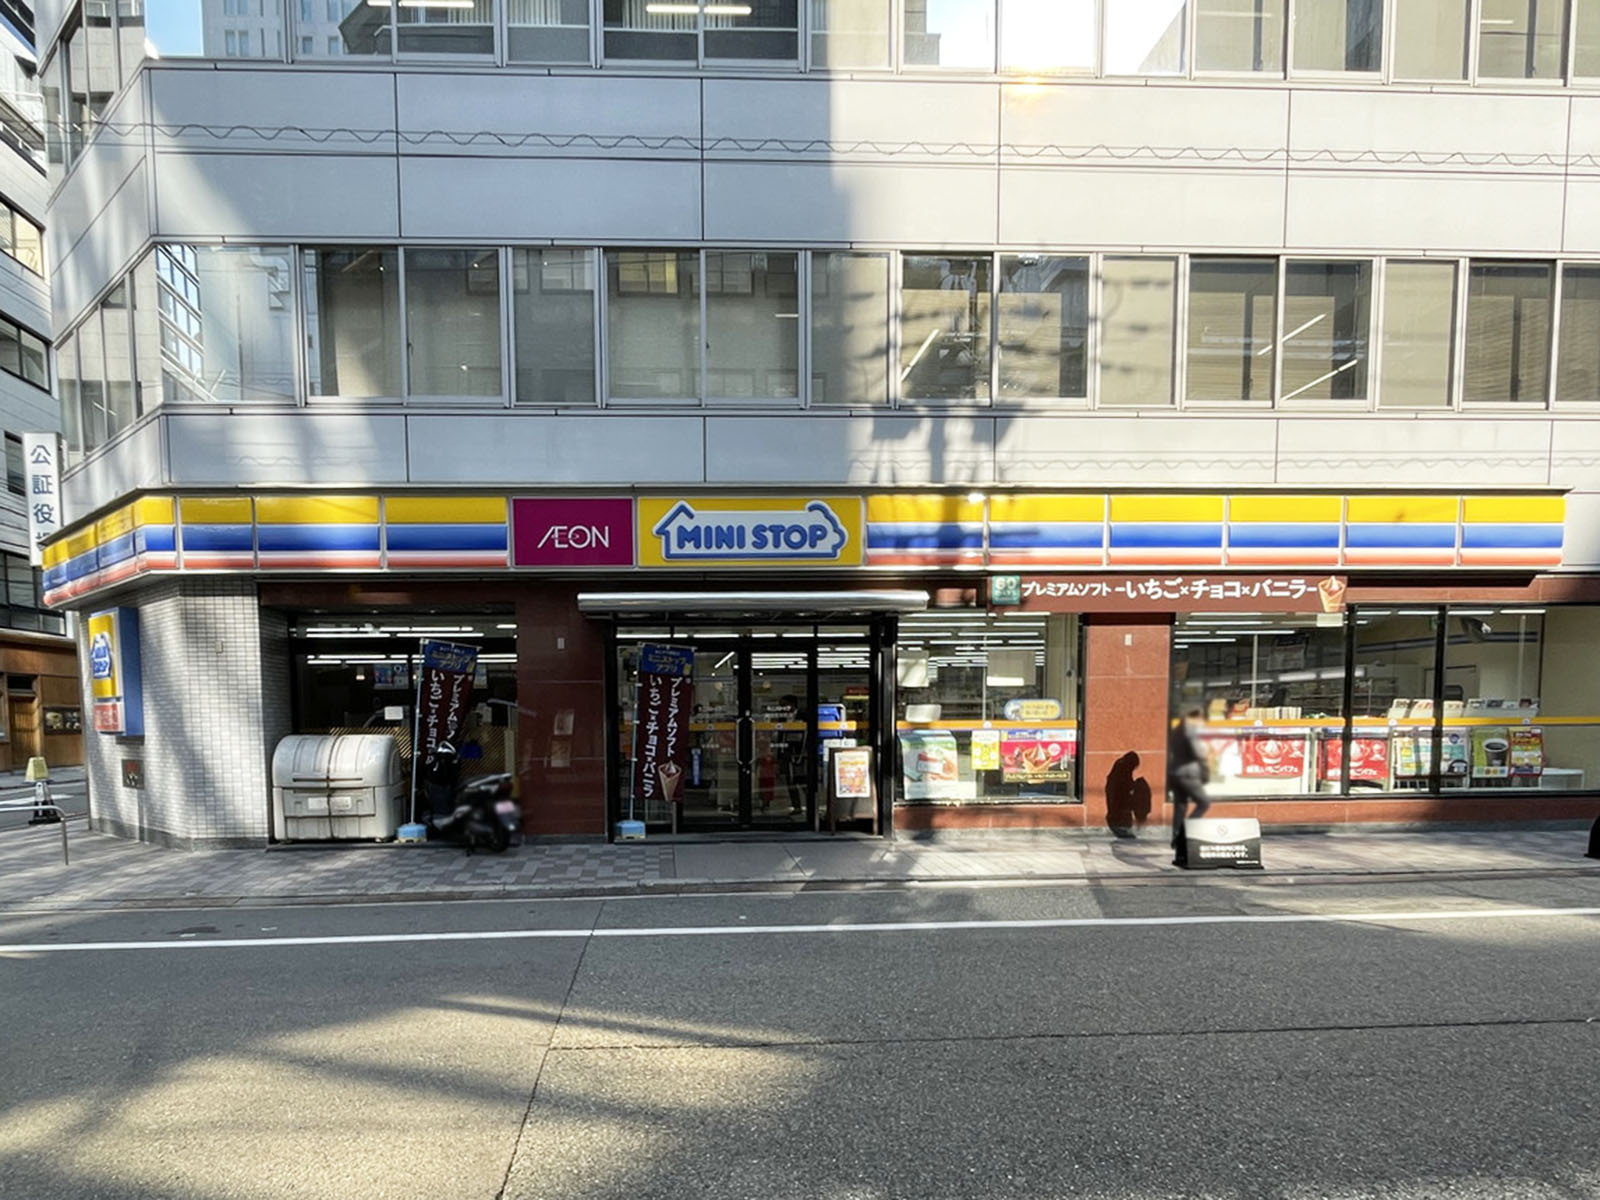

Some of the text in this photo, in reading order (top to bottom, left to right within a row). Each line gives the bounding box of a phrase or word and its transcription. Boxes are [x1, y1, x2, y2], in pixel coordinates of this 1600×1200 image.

[30, 445, 55, 539] 公証役
[676, 524, 828, 550] MINI STOP
[667, 676, 683, 757] プレミアムソフト
